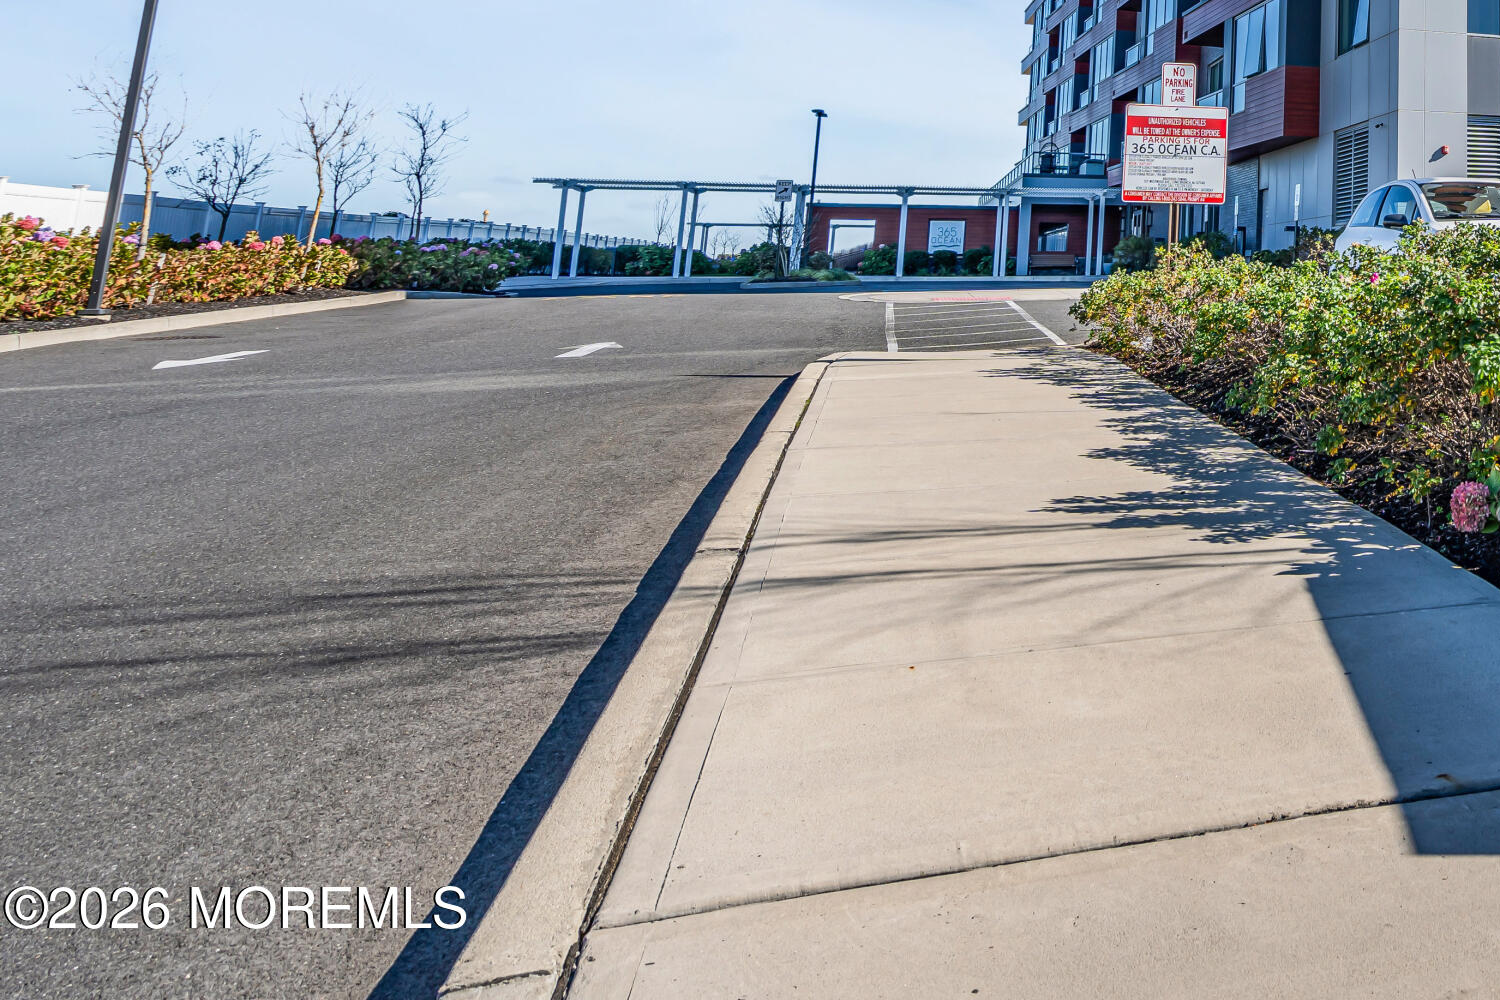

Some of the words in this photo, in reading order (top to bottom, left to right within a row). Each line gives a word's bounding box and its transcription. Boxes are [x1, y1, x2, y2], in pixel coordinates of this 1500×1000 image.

[1173, 68, 1185, 77] NO
[1165, 78, 1193, 87] PARKING
[1148, 117, 1182, 126] UNAUTHORIZED
[1132, 126, 1143, 135] WILL
[1143, 127, 1150, 135] BE
[1150, 127, 1165, 135] TOWED
[1165, 127, 1172, 136] AT
[1172, 128, 1181, 136] THE
[1142, 136, 1180, 144] PARKING
[1131, 143, 1154, 154] 365
[1158, 144, 1197, 155] OCEAN
[1200, 145, 1221, 156] C.A.
[937, 226, 957, 237] 365
